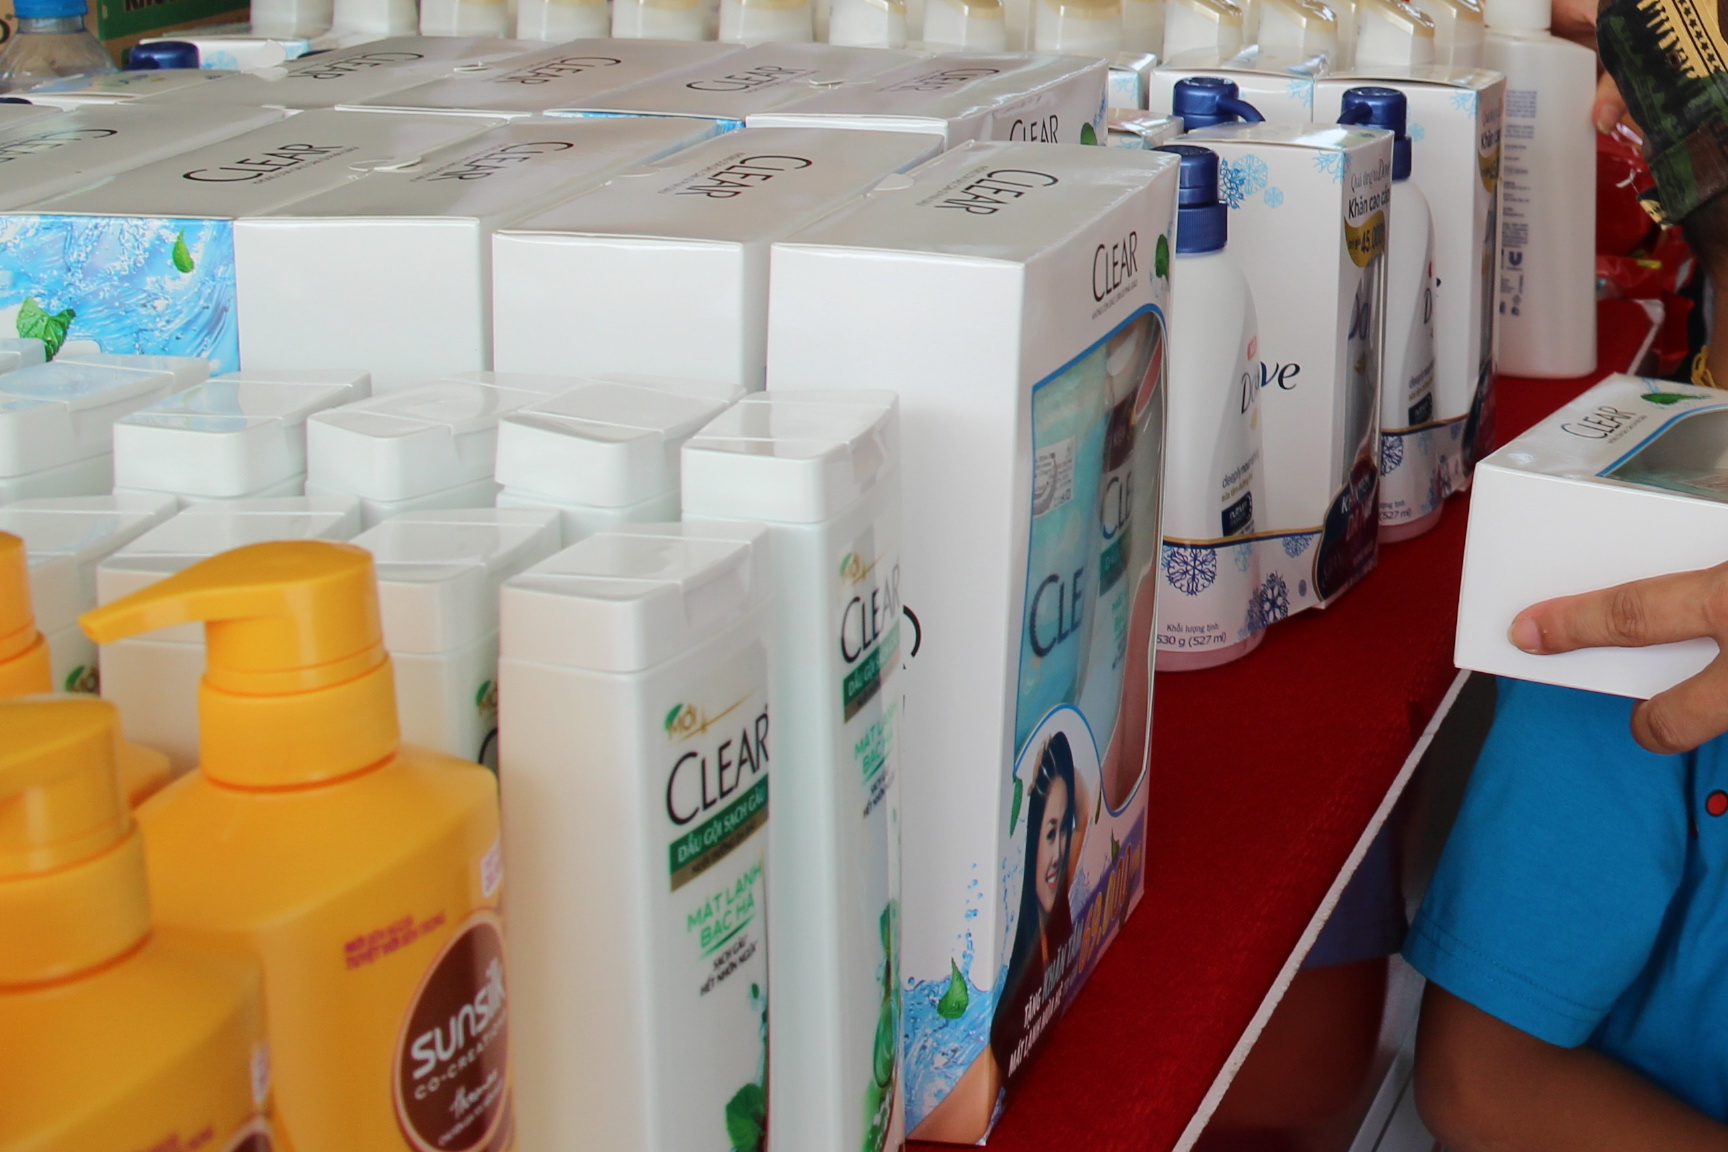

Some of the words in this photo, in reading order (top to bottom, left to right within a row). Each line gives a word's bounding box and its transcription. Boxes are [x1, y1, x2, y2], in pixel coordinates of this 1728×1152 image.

[686, 65, 807, 93] CLEAR
[183, 143, 343, 184] CLEAR
[430, 141, 574, 182] CLEAR
[676, 154, 813, 200] CLEAR
[934, 169, 1059, 215] CLEAR
[1092, 231, 1138, 302] CLEAR
[1560, 405, 1638, 440] CLEAR
[1178, 638, 1186, 647] g
[1188, 634, 1212, 647] (527
[666, 712, 769, 826] CLEAR
